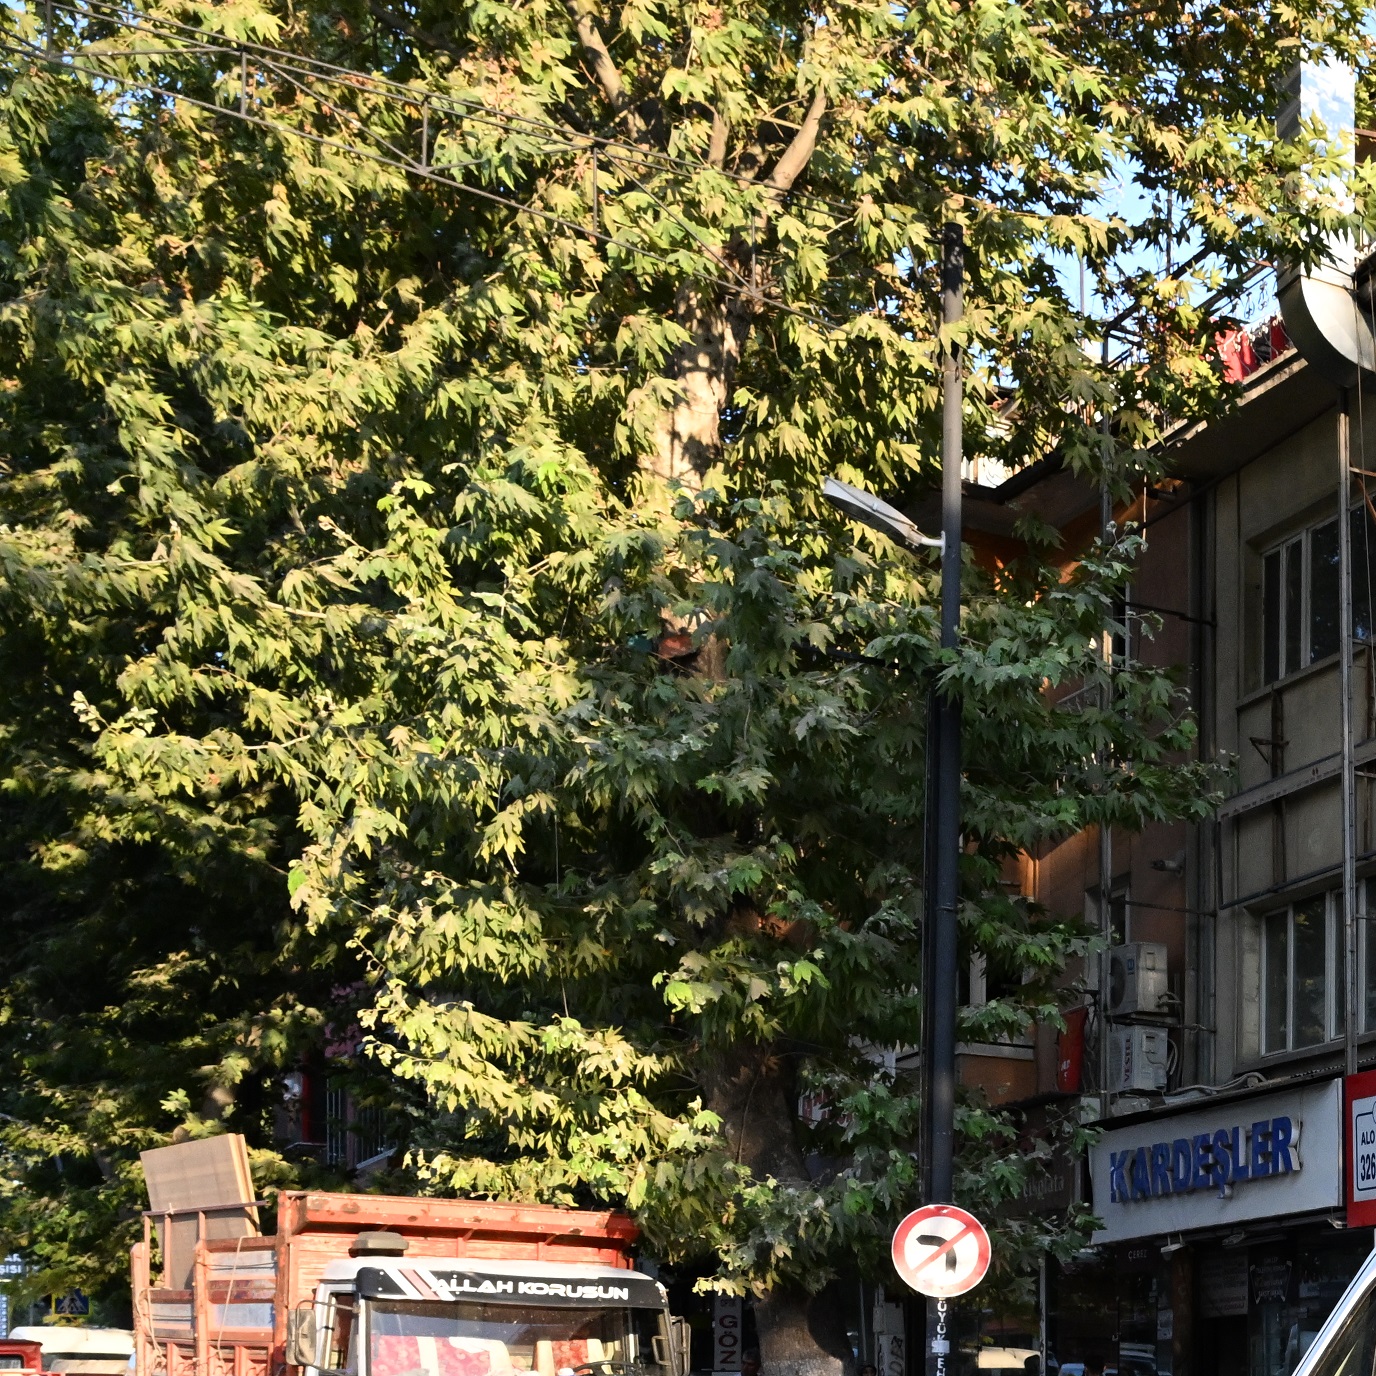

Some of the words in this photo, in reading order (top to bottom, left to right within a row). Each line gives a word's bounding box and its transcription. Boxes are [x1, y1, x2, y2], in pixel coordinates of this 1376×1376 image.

[1361, 1130, 1375, 1146] ALO
[1110, 1116, 1300, 1203] KARDEŞLER
[1360, 1153, 1376, 1181] 326
[434, 1279, 513, 1294] ALLAH
[518, 1282, 629, 1300] KORUSUN
